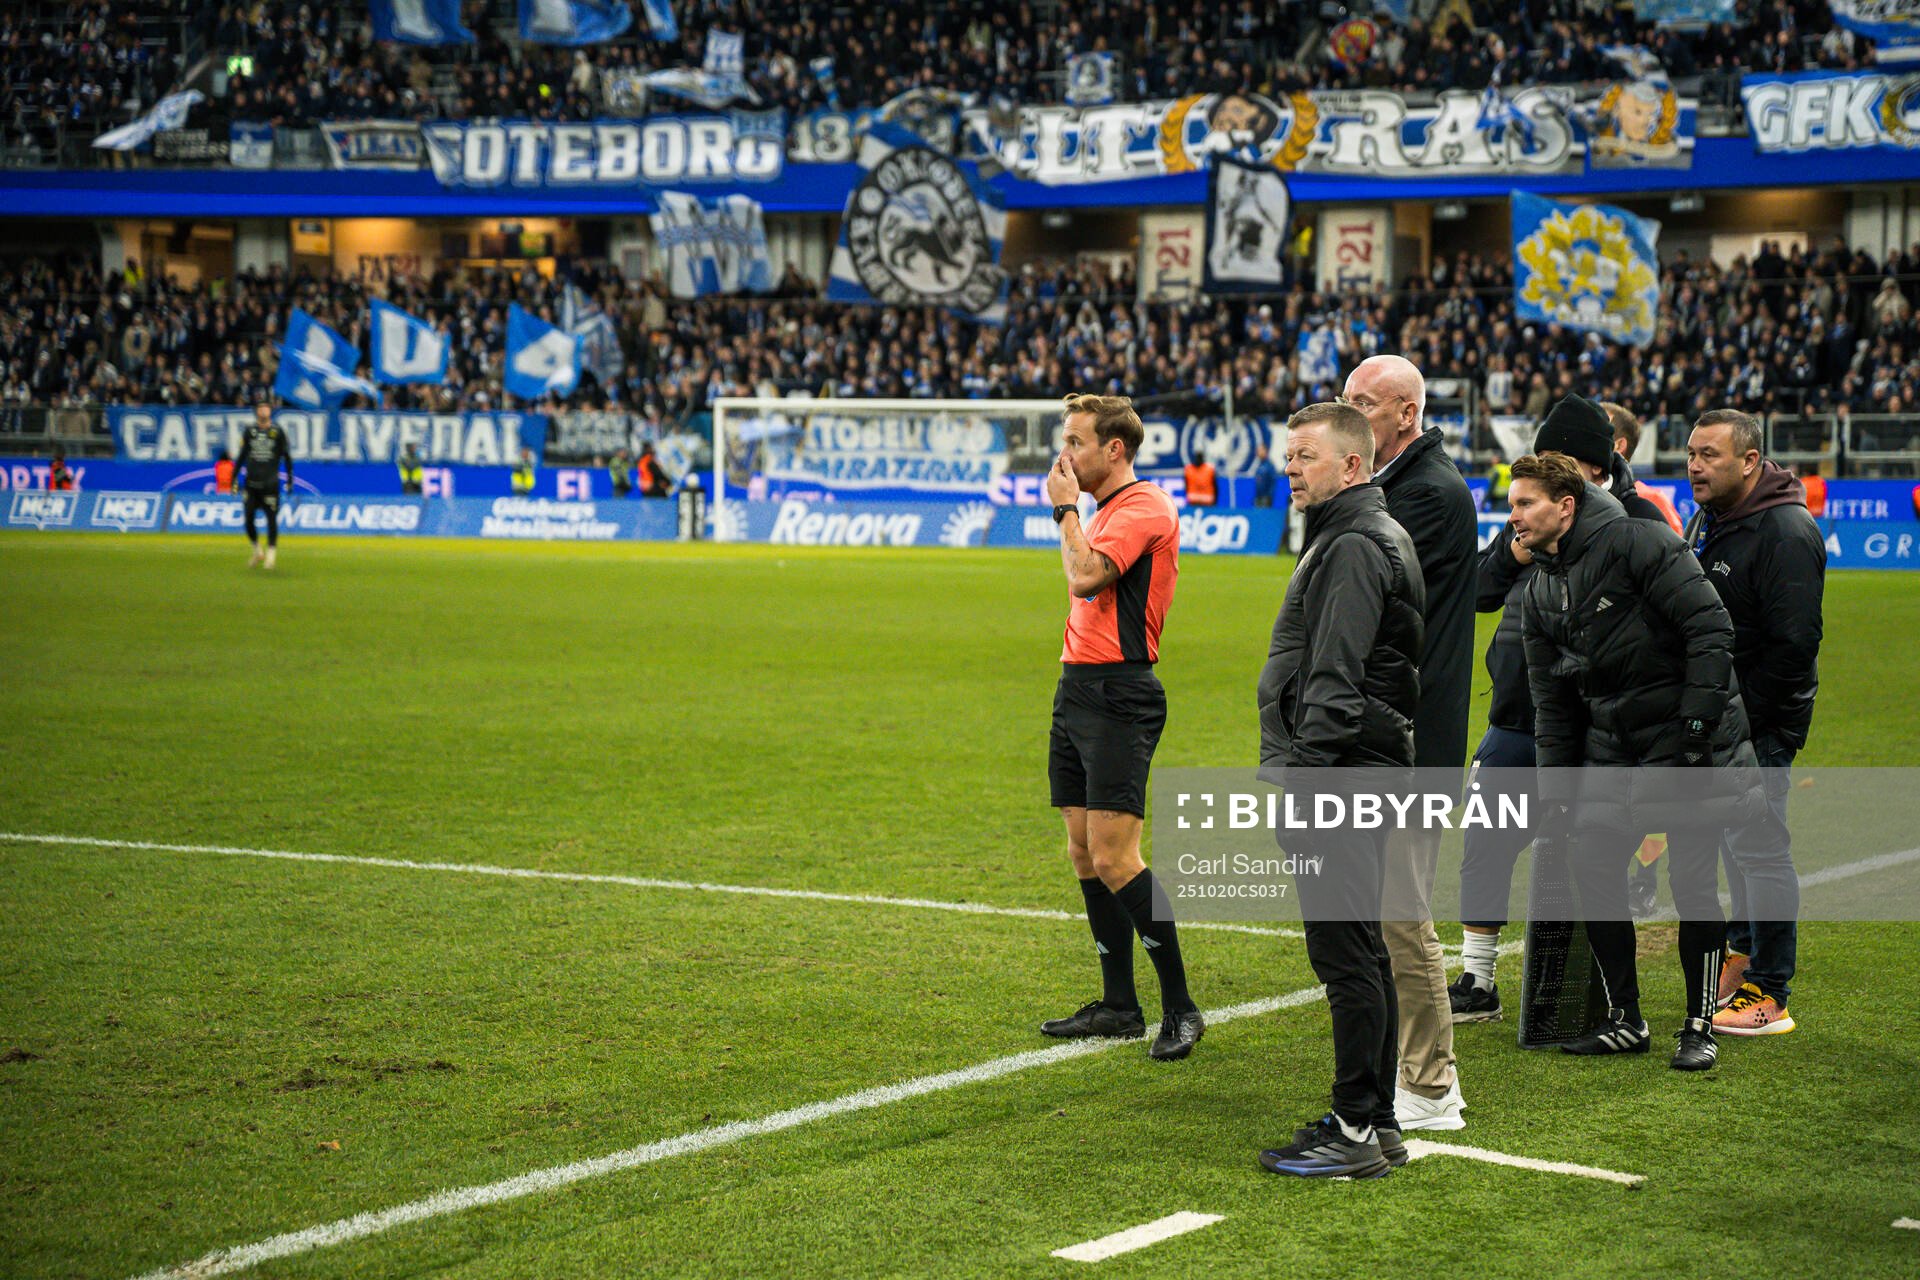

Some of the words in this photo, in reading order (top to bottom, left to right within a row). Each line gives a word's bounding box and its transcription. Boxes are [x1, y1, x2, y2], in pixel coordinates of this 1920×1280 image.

[171, 501, 267, 527] NORD
[276, 503, 421, 531] WELLNESS
[769, 499, 922, 546] Renova
[1864, 532, 1920, 559] GR
